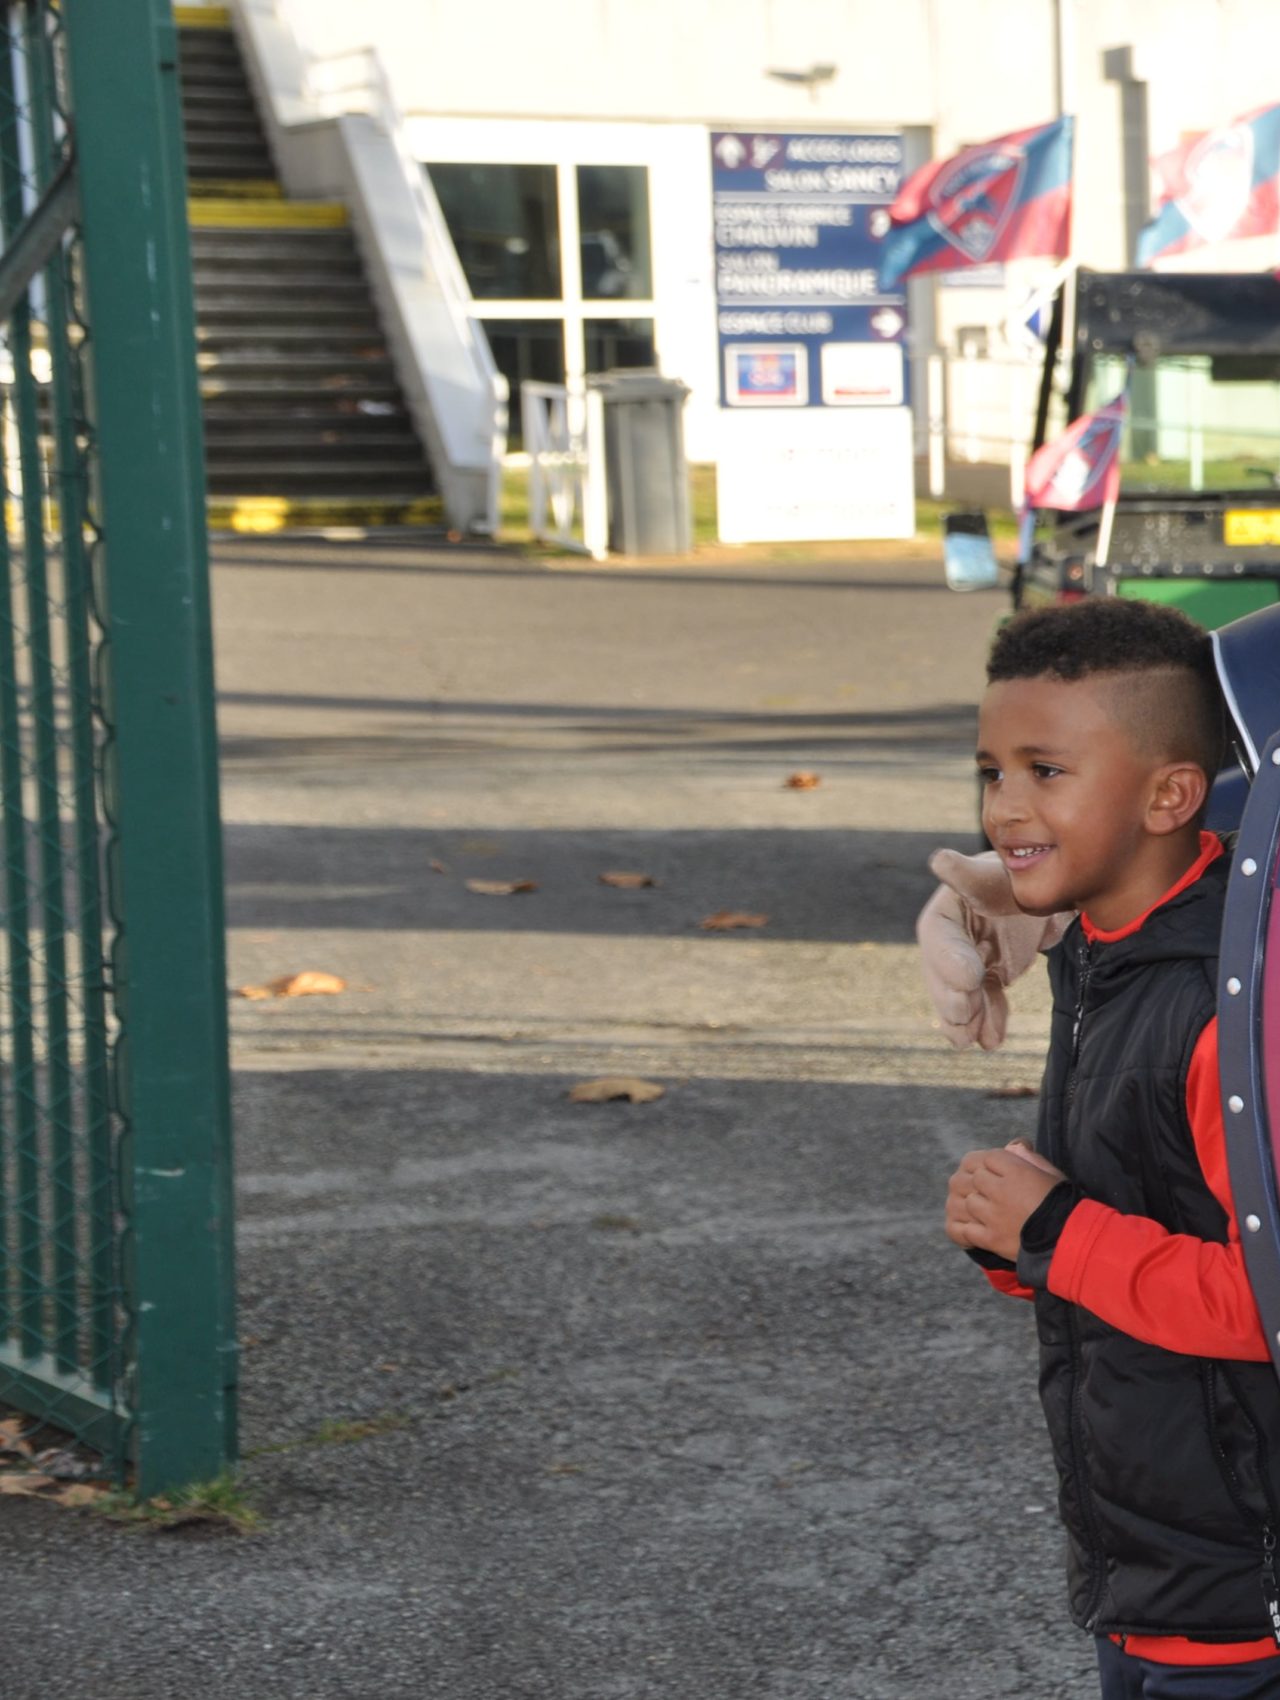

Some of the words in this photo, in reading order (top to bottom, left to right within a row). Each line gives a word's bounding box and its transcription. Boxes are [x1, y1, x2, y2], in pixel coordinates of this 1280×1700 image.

[824, 166, 899, 192] SANCY
[718, 270, 877, 296] PANORAMIQUE
[718, 312, 782, 334] ESPACE
[784, 313, 832, 334] CLUB
